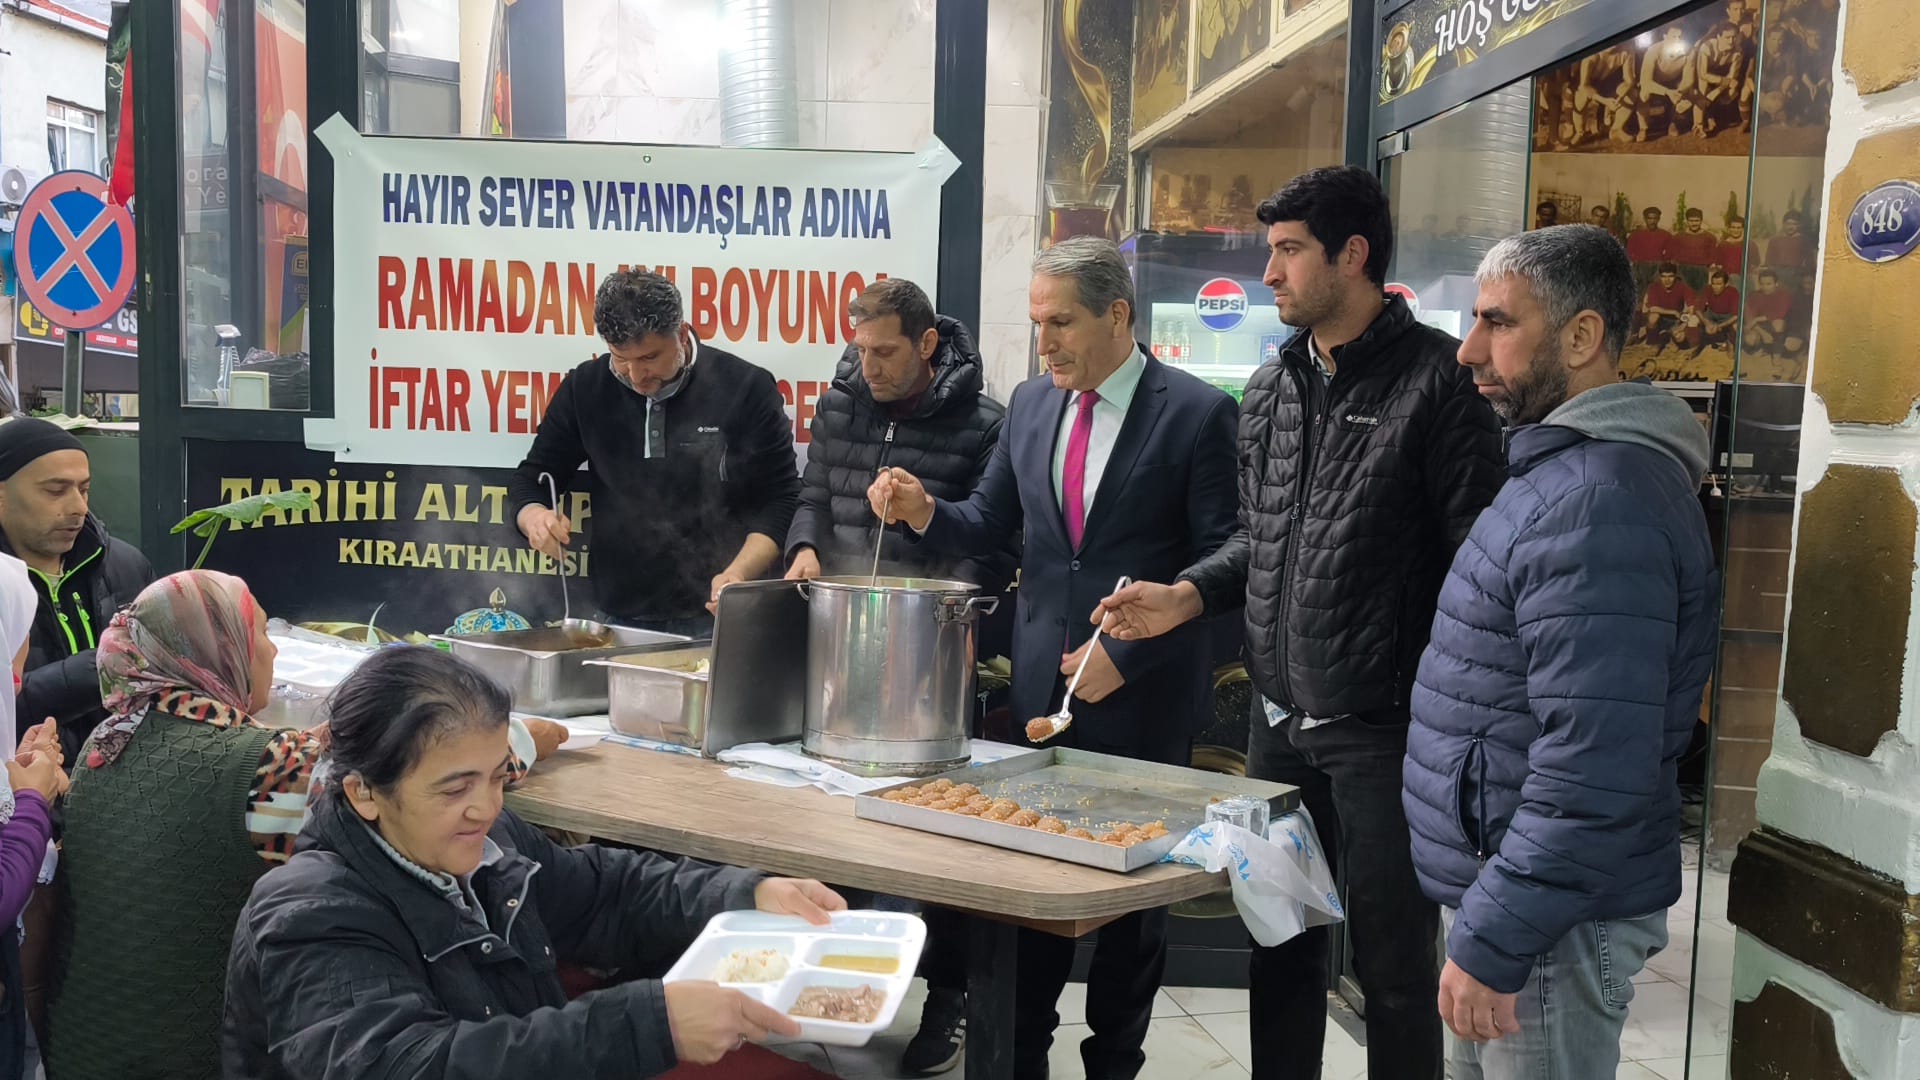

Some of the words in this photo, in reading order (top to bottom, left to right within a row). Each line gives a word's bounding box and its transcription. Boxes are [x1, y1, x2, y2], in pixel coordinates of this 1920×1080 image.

[1434, 0, 1492, 57] HOŞ
[382, 172, 471, 229] HAYIR
[478, 176, 575, 230] SEVER
[583, 180, 791, 250] VATANDAŞLAR
[800, 187, 892, 240] ADINA
[1861, 199, 1903, 236] 848
[378, 256, 596, 337] RAMADAN
[692, 266, 888, 345] BOYUNC
[1199, 298, 1245, 311] PEPSI
[369, 348, 471, 433] İFTAR
[221, 468, 398, 531] TARİHİ
[338, 537, 590, 578] KIRAATHANESİ
